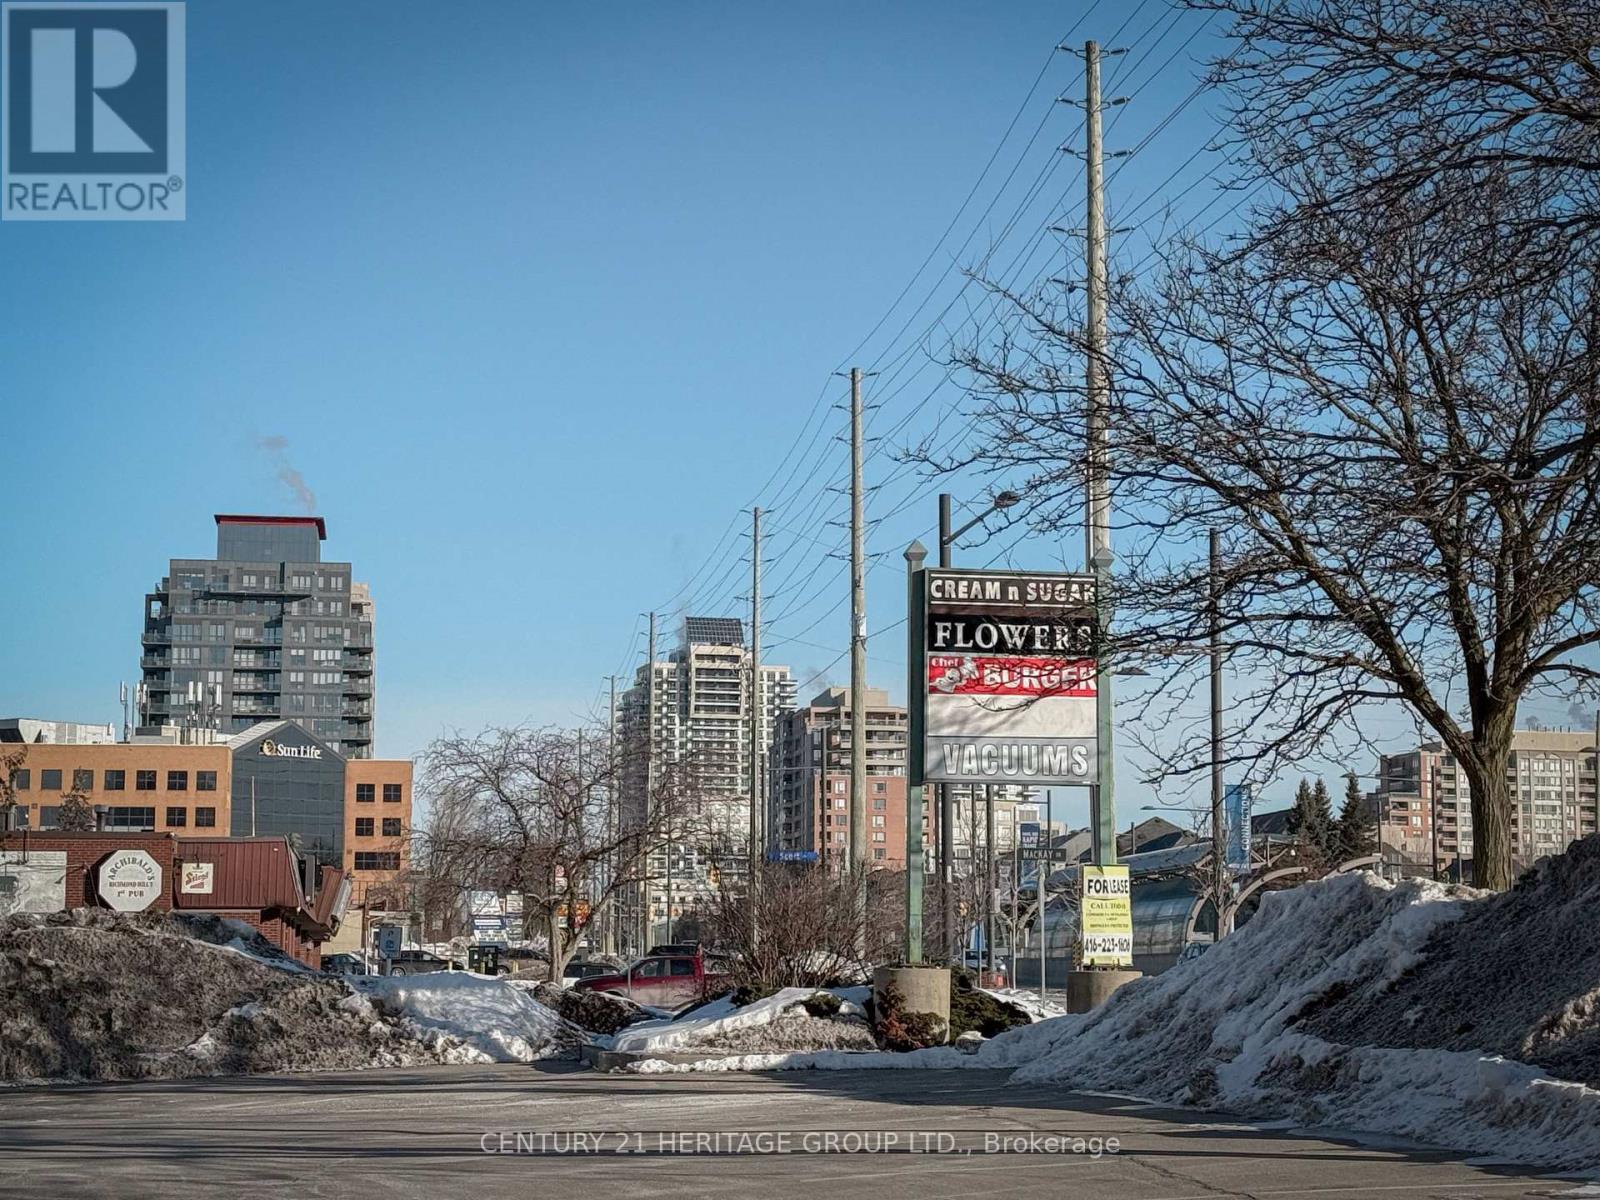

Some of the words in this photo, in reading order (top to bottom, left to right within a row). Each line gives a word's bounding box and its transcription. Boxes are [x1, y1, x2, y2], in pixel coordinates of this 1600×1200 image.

[930, 579, 1001, 600] CREAM
[1007, 586, 1019, 601] n
[1026, 582, 1096, 603] SUGAR
[934, 622, 1093, 651] FLOWERS
[931, 657, 960, 667] Chef
[983, 664, 1097, 691] BURGER
[277, 744, 299, 757] Sun
[300, 745, 322, 759] Life
[942, 743, 1089, 777] VACUUMS
[1241, 787, 1250, 851] CONNECTIONS
[1023, 849, 1054, 860] MACKAY
[107, 857, 156, 881] ARCHIBALD'S
[128, 889, 145, 898] PUB
[1087, 878, 1109, 894] FOR
[1109, 879, 1129, 894] LEASE
